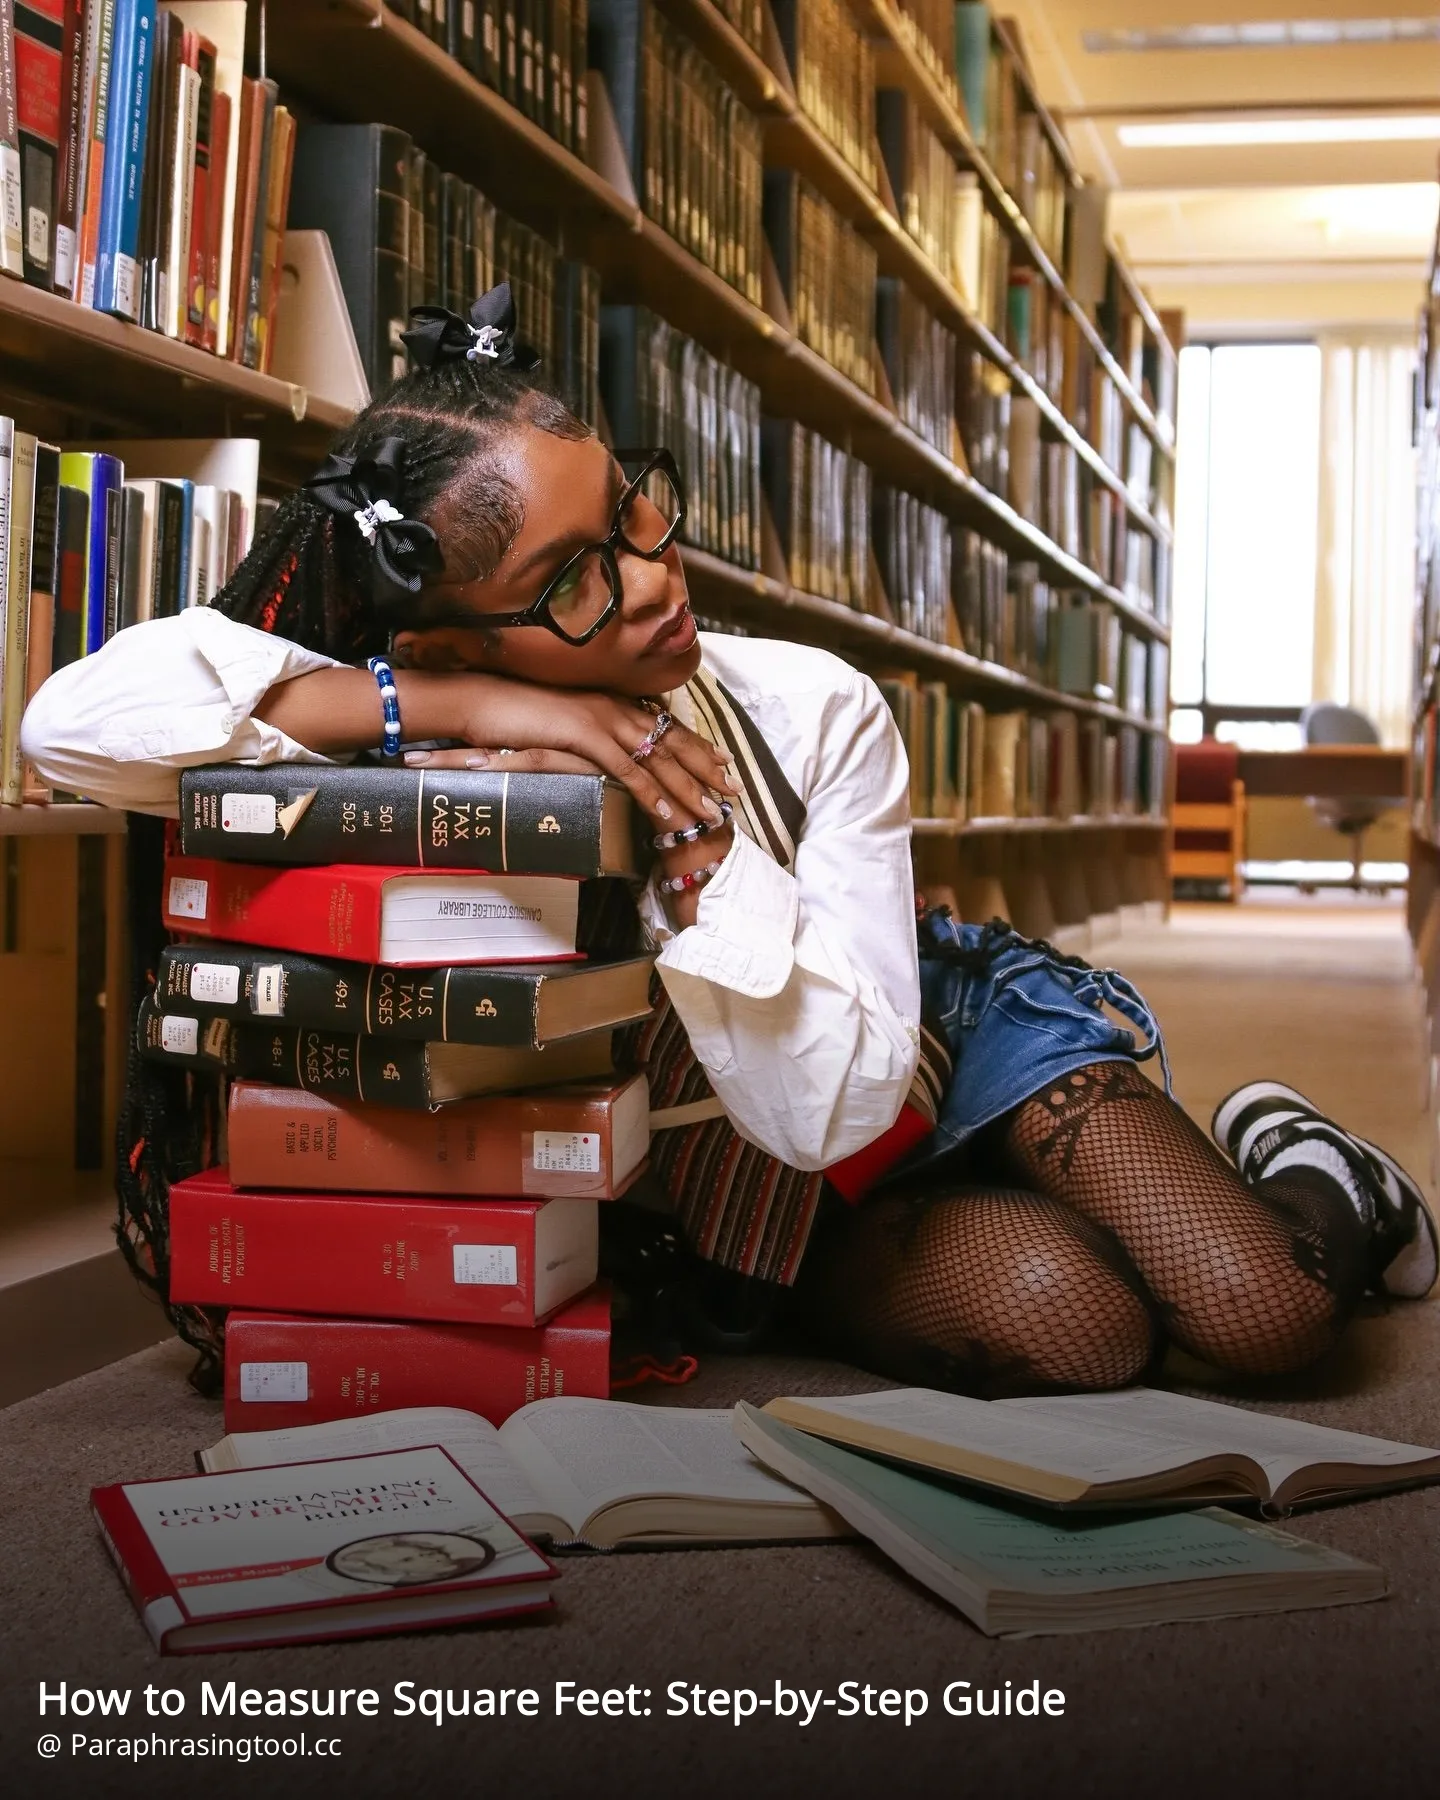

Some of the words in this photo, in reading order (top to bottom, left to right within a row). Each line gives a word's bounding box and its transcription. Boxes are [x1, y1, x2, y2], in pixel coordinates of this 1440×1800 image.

[104, 0, 114, 28] TAXES
[102, 30, 110, 50] ARE
[138, 36, 146, 66] FEDERAL
[6, 87, 13, 101] of
[72, 90, 78, 101] in
[98, 62, 109, 106] WOMAN'S
[135, 71, 144, 106] TAXATION
[7, 106, 15, 134] 1986
[71, 106, 79, 124] Tax
[96, 108, 105, 137] ISSUE
[134, 109, 141, 118] IN
[131, 120, 140, 152] AMERICA
[68, 128, 77, 211] Administration
[20, 537, 25, 547] in
[17, 570, 25, 602] Policy
[16, 605, 24, 650] Analysis
[342, 802, 356, 833] 50-2
[363, 810, 373, 827] and
[379, 805, 393, 833] 50-1
[432, 794, 449, 847] CASES
[454, 802, 471, 840] TAX
[438, 900, 471, 917] LIBRARY
[472, 903, 508, 918] COLLEGE
[509, 905, 542, 922] CANISIUS
[174, 964, 183, 993] CLEARING
[182, 962, 190, 996] COMMERCE
[244, 974, 254, 997] Index
[334, 979, 349, 1010] 49-1
[378, 972, 395, 1025] CASES
[399, 983, 415, 1019] TAX
[475, 998, 498, 1017] CCH
[271, 1036, 283, 1067] 48-1
[306, 1032, 321, 1084] CASES
[322, 1043, 336, 1080] TAX
[383, 1062, 400, 1081] CCH
[286, 1132, 295, 1154] BASIC
[300, 1123, 309, 1152] APPLIED
[313, 1127, 323, 1152] SOCIAL
[327, 1116, 337, 1161] PSYCHOLOGY
[1252, 1128, 1281, 1164] NIKE
[209, 1224, 219, 1235] OF
[222, 1216, 232, 1246] SOCIAL
[209, 1238, 219, 1273] JOURNAL
[235, 1224, 245, 1277] PSYCHOLOGY
[383, 1243, 392, 1254] 30
[410, 1250, 419, 1272] 2000
[222, 1248, 232, 1284] APPLIED
[383, 1257, 393, 1275] VOL.
[341, 1376, 351, 1397] 2000
[370, 1372, 380, 1390] VOL.
[540, 1357, 550, 1394] APPLIED
[370, 1393, 379, 1404] 30
[158, 1478, 436, 1517] UNDERSTANDING
[160, 1486, 438, 1527] GOVERNMENT
[304, 1496, 453, 1522] BUDGETS
[1039, 1563, 1170, 1577] BUDGET
[1176, 1556, 1251, 1568] THE
[197, 1572, 236, 1582] Mark
